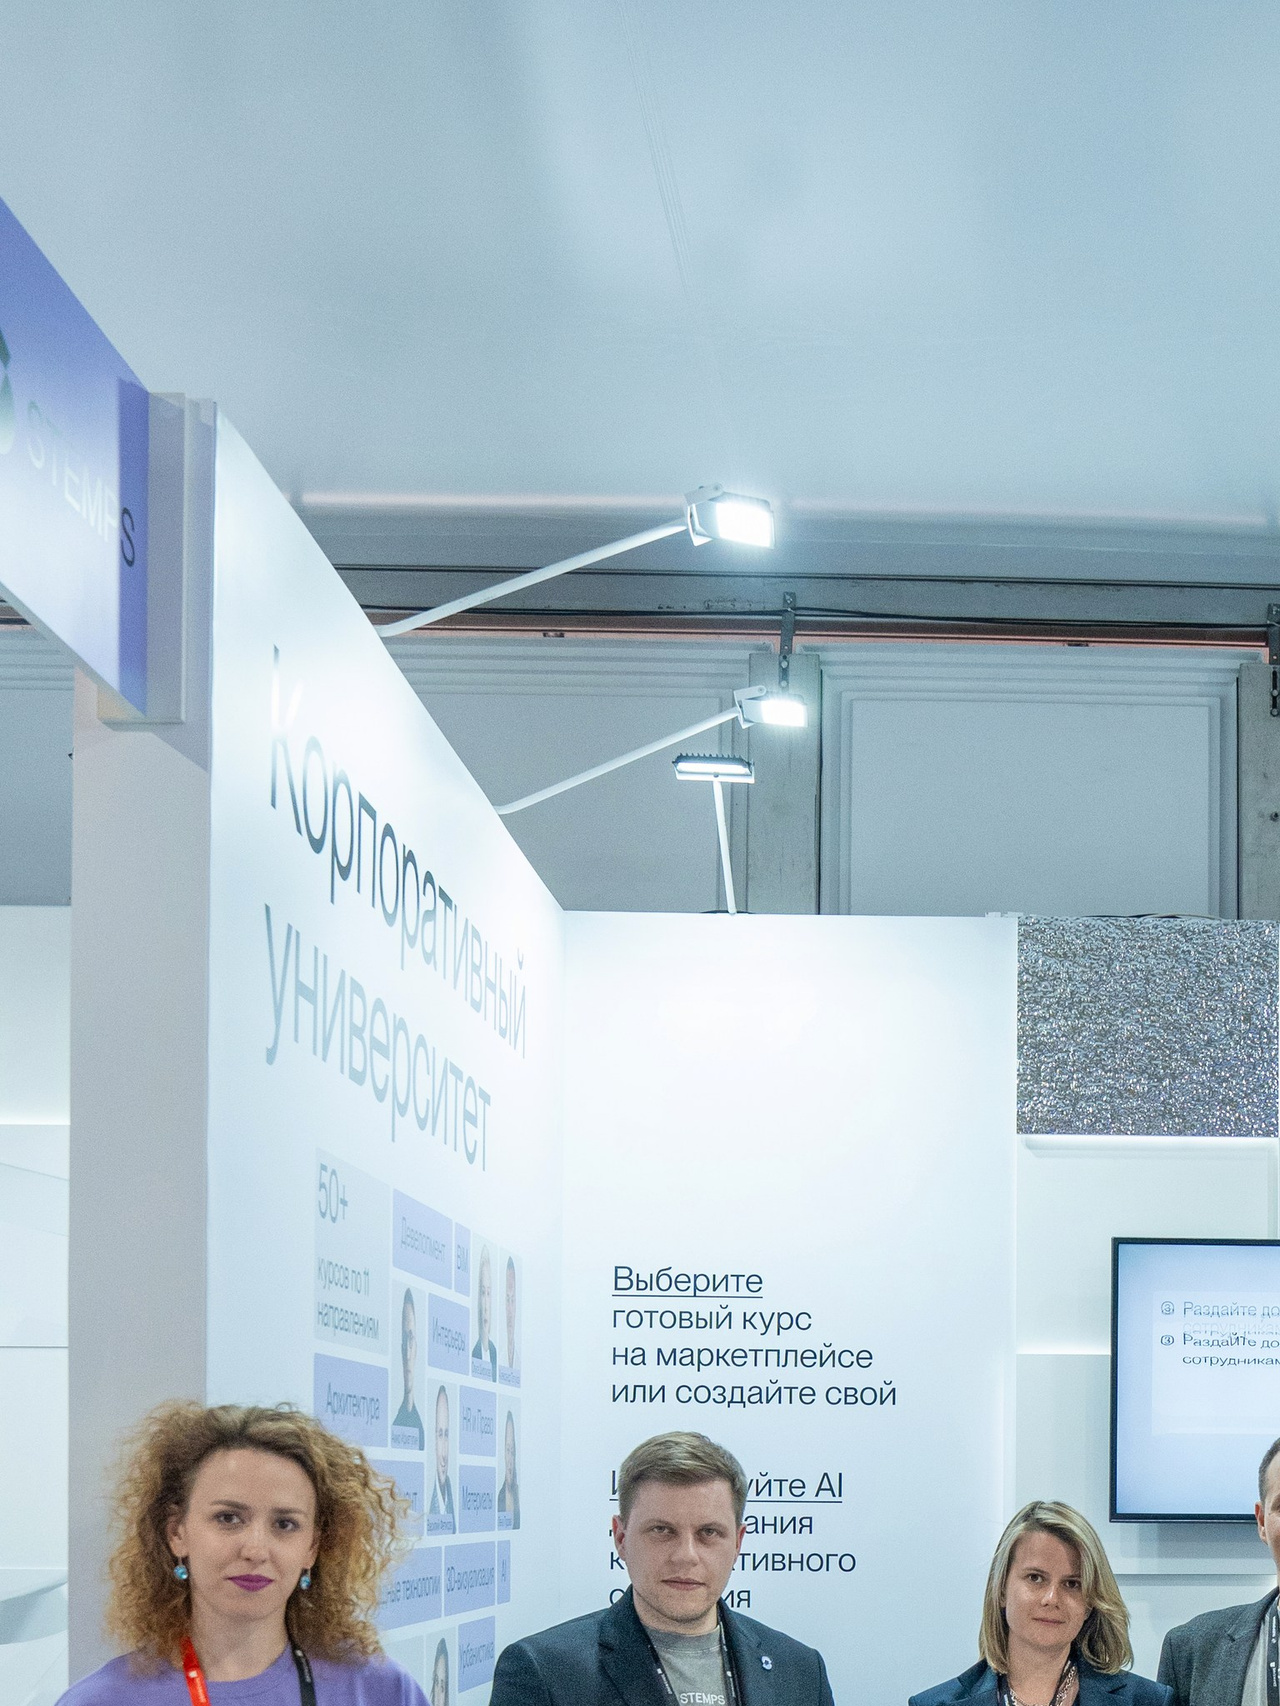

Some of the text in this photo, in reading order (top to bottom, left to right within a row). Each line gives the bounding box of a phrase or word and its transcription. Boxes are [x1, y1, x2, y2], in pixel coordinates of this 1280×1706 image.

[27, 401, 136, 568] STEMPS
[271, 645, 526, 1059] Корпоративный
[265, 903, 490, 1171] университет
[318, 1163, 348, 1223] 50+
[318, 1257, 349, 1291] курсов
[351, 1270, 362, 1294] по
[614, 1266, 763, 1296] Выберите
[318, 1301, 380, 1340] направлениям
[613, 1305, 812, 1335] готовый курс
[1183, 1302, 1257, 1318] Раздайте
[1183, 1332, 1257, 1348] Раздайте
[612, 1343, 873, 1371] на маркетплейсе
[612, 1379, 896, 1408] или создайте свой
[815, 1472, 843, 1497] AI
[679, 1692, 725, 1705] STEMPS
